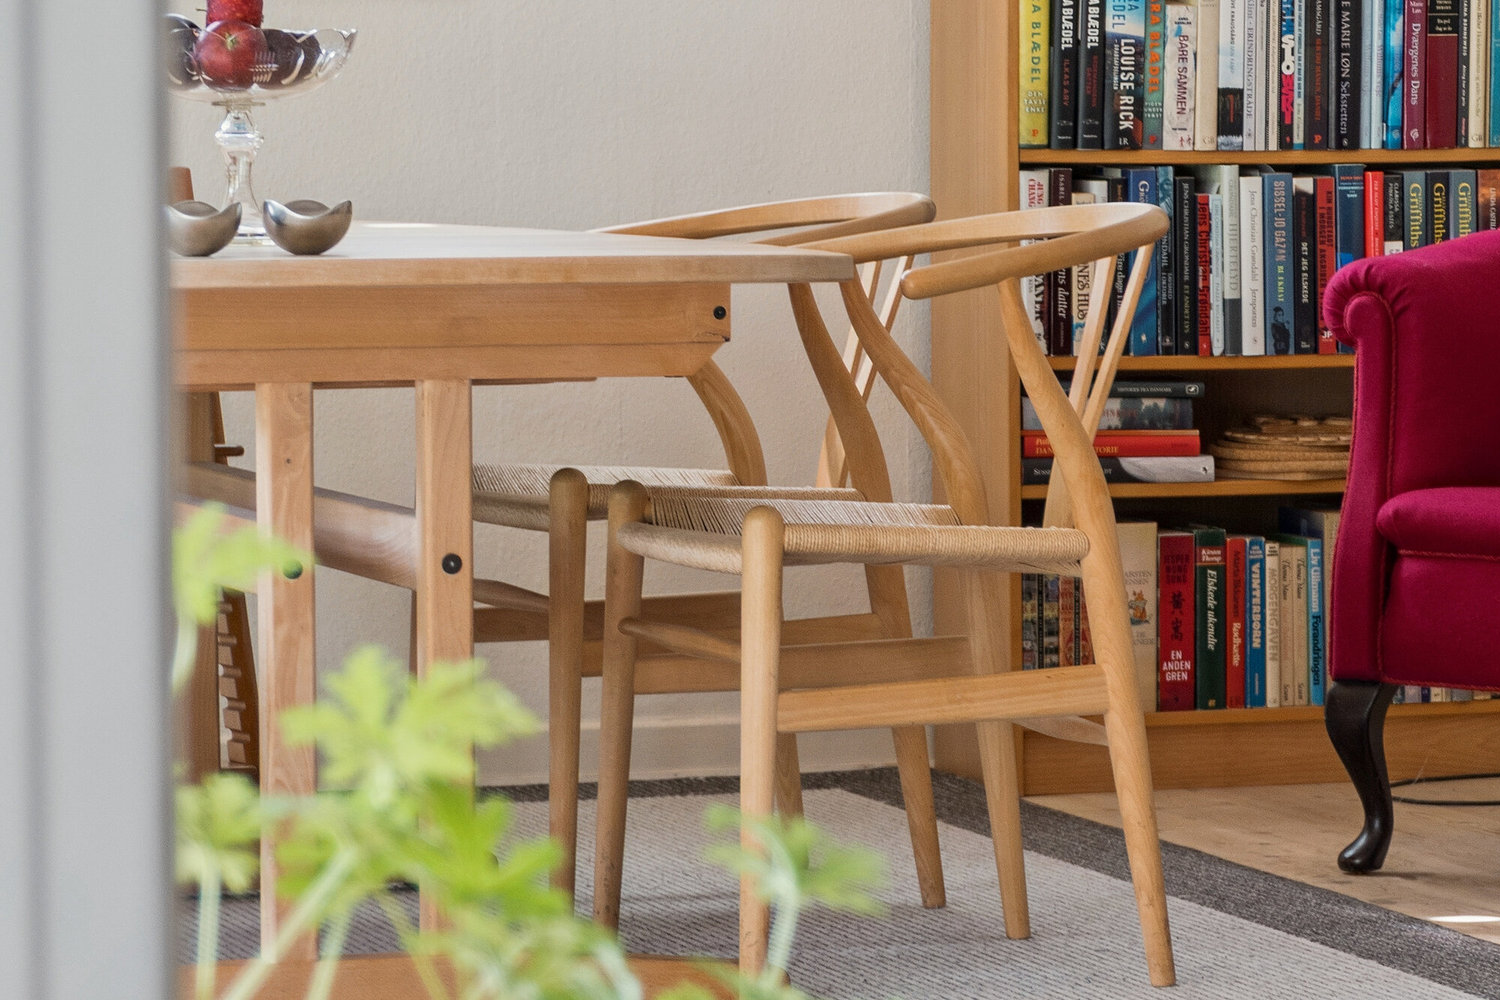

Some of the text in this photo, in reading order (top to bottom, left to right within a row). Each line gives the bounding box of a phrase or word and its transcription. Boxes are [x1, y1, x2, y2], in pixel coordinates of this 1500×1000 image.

[1061, 8, 1074, 50] BLÆDEL
[1087, 6, 1100, 49] BLÆDEL
[1178, 35, 1190, 63] BARE
[1340, 11, 1351, 48] MARIE
[1031, 22, 1042, 83] BLÆDEL
[1149, 32, 1161, 94] BLÆDEL
[1340, 52, 1351, 77] LØN
[1410, 23, 1421, 105] Dværgenes Dans
[1119, 38, 1136, 130] LOUISE RICK
[1176, 67, 1189, 115] SAMMEN
[1340, 81, 1350, 134] Sekstetten
[1027, 178, 1037, 208] CHANG
[1036, 181, 1045, 205] JUNG
[1182, 183, 1190, 199] JENS
[1274, 181, 1286, 227] SISSEL-JO
[1458, 182, 1472, 238] Griffith
[1409, 183, 1423, 248] Griffiths
[1433, 183, 1446, 244] Griffiths
[1489, 207, 1497, 230] CASTILL
[1198, 202, 1210, 337] Jens Christian Grøndahl
[1249, 190, 1259, 328] Jens Christian Grøndahl Jernporten
[1057, 288, 1069, 319] datter
[1115, 272, 1126, 293] dage
[1077, 293, 1091, 320] HUS
[1207, 569, 1218, 651] Elskede ukendte
[1252, 562, 1262, 648] VINTERBØRN
[1311, 548, 1322, 685] Liv Ullmann Forandringen
[1162, 660, 1191, 671] ANDEN
[1166, 671, 1188, 681] GREN
[1171, 650, 1183, 660] EN
